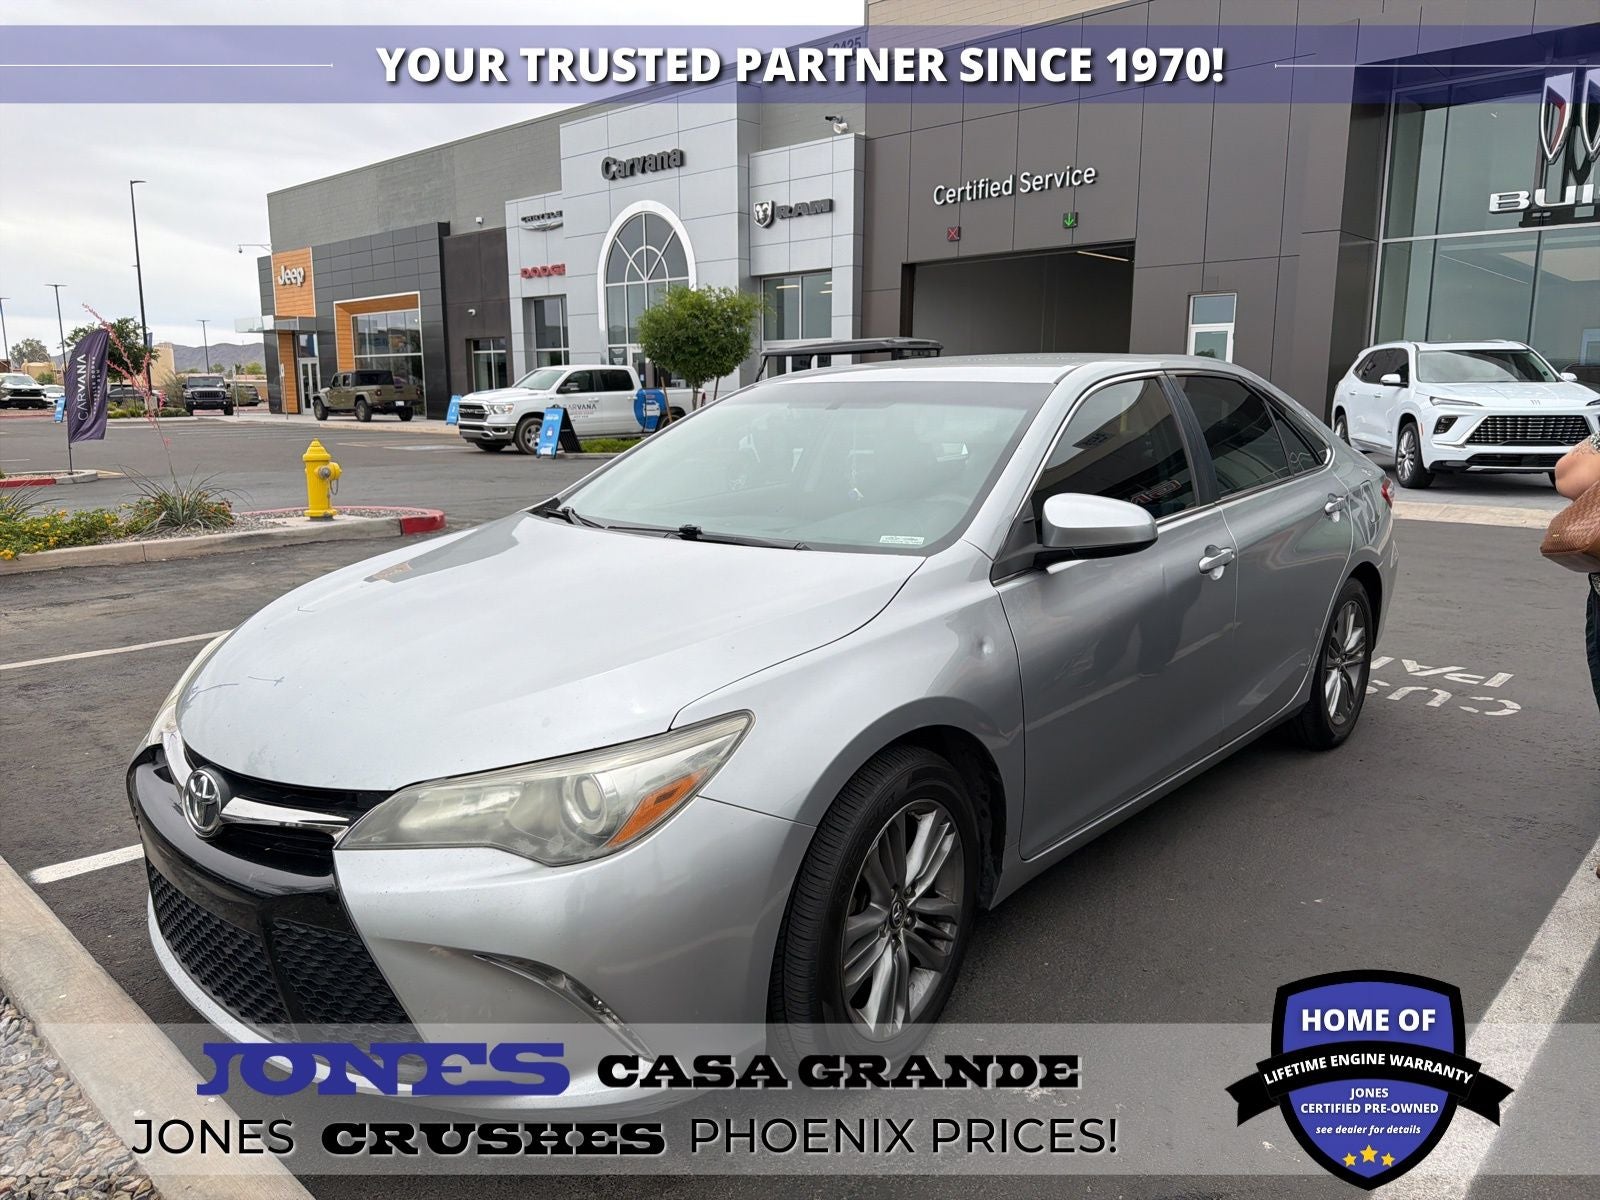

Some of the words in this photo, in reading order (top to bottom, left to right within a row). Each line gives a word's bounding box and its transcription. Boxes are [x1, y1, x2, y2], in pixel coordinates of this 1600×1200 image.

[601, 148, 685, 181] Carvana
[933, 174, 1014, 206] Certified
[1019, 165, 1096, 193] Service
[1489, 183, 1600, 212] BUI
[775, 198, 834, 219] RAM
[278, 265, 305, 288] Jeep
[76, 353, 89, 421] CARVANA
